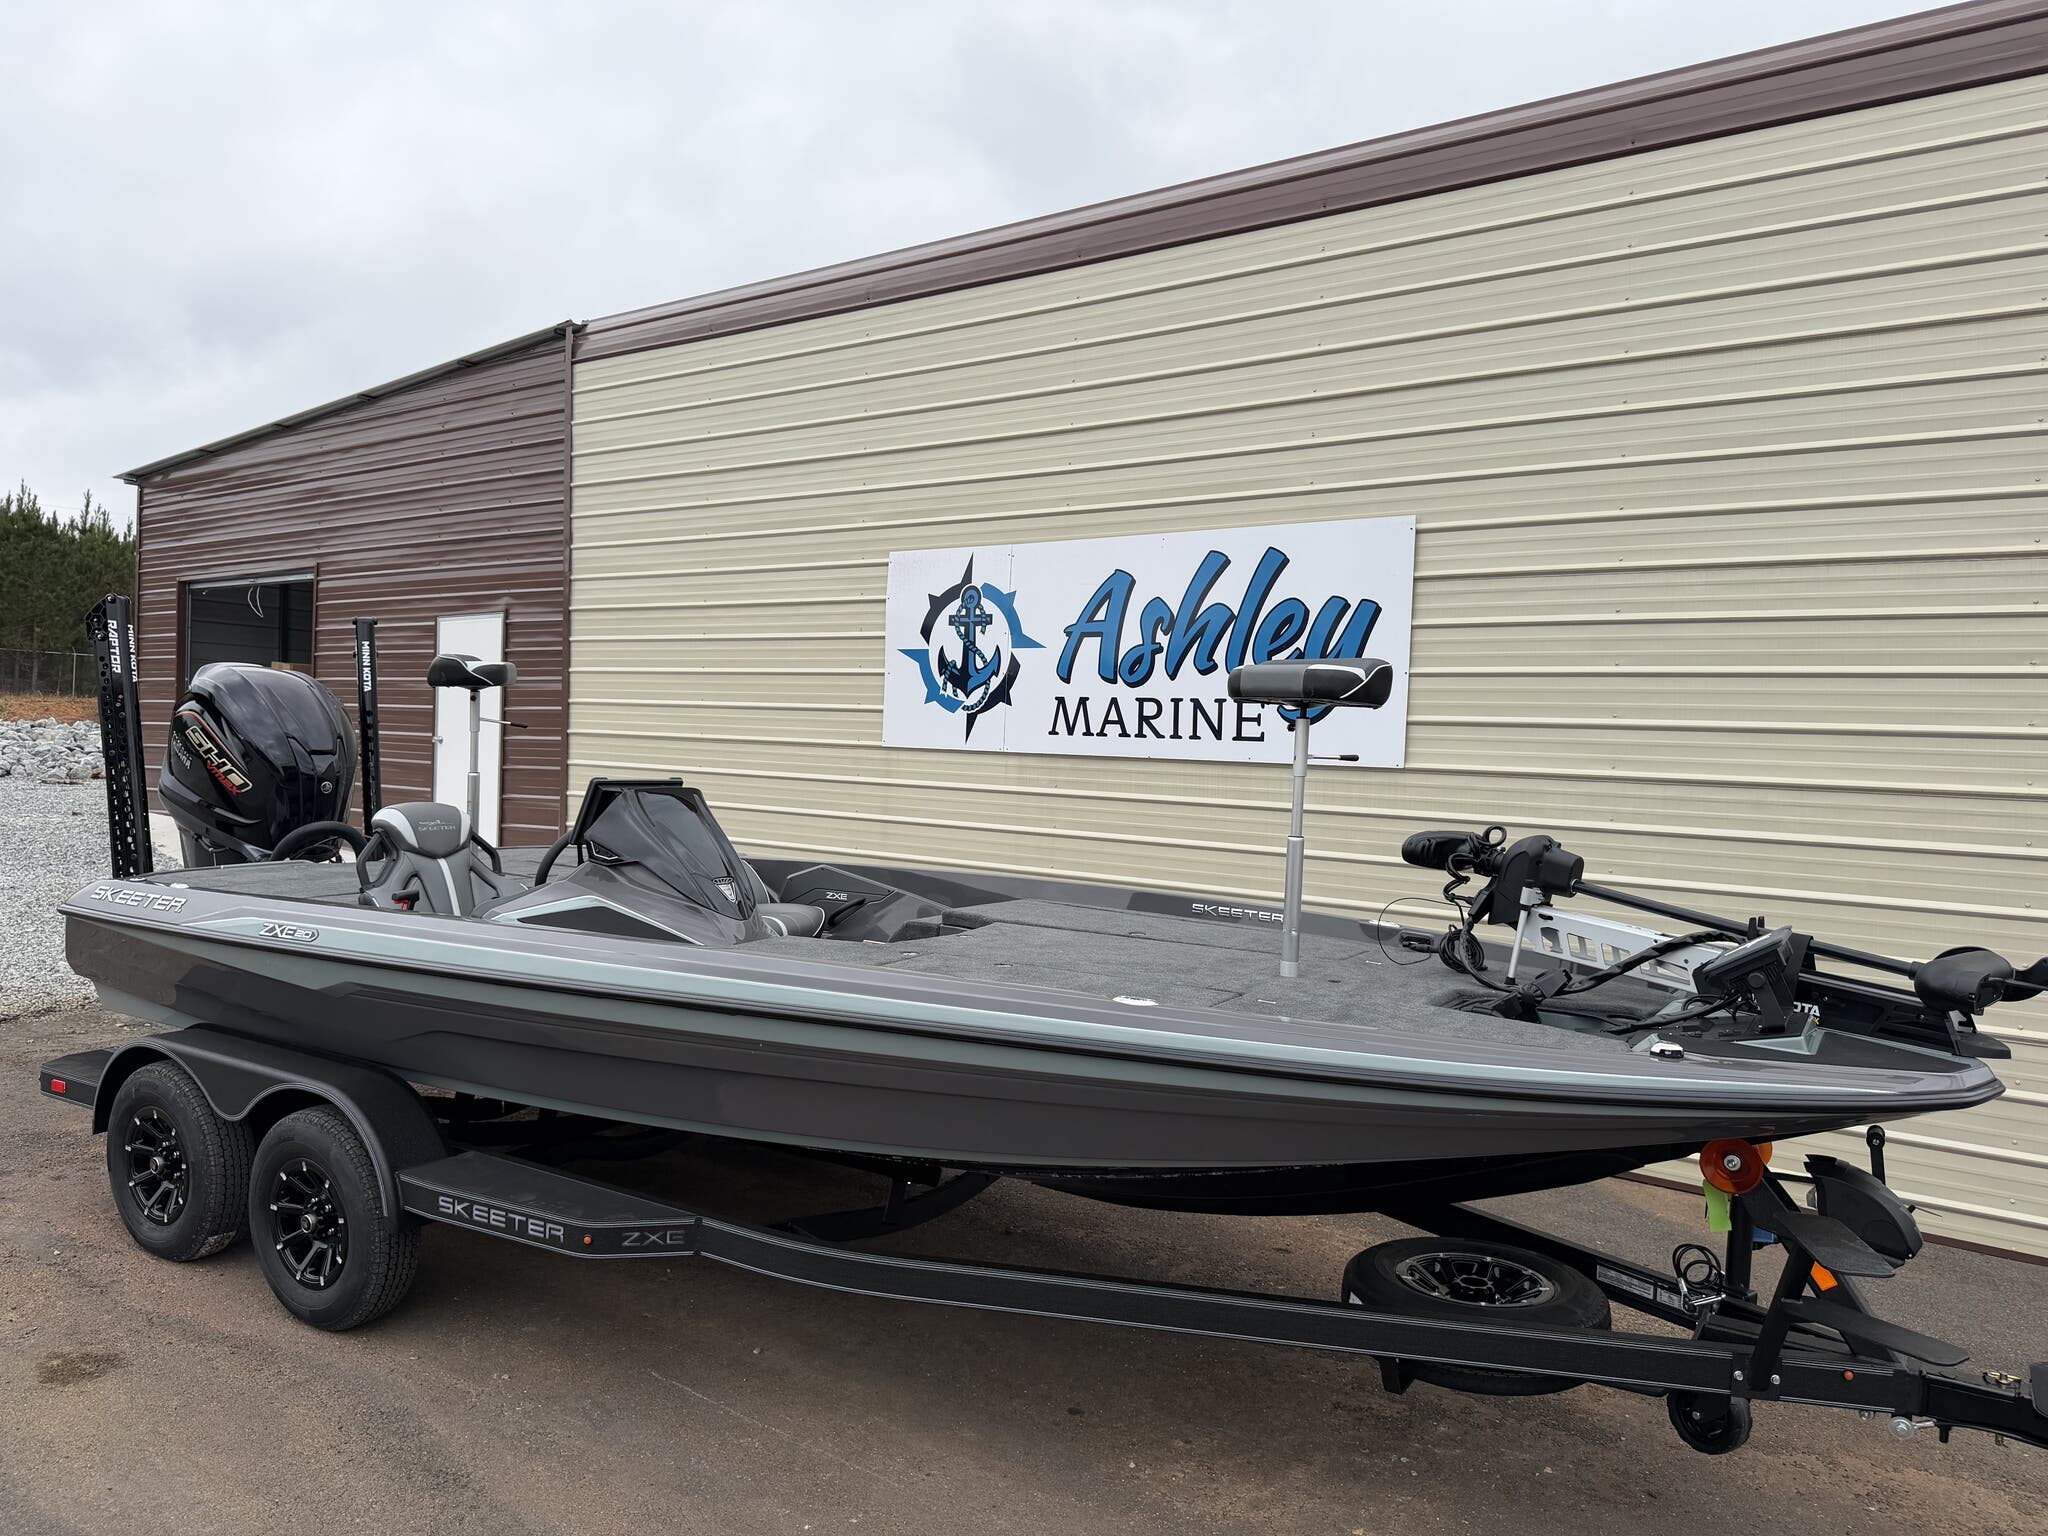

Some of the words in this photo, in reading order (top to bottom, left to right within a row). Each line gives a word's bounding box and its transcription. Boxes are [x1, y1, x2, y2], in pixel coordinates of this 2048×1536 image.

[107, 619, 122, 674] RAPTOR
[127, 624, 136, 653] MINN
[1056, 546, 1382, 726] Ashley
[361, 640, 371, 667] MINN
[130, 654, 138, 682] KOTA
[363, 667, 372, 692] KOTA
[1048, 695, 1266, 743] MARINE
[185, 725, 253, 793] SHO
[90, 886, 187, 913] SKEETER
[825, 892, 848, 901] ZXE
[1191, 903, 1284, 923] SKEETER
[438, 1196, 565, 1243] SKEETER
[621, 1229, 685, 1247] ZXE
